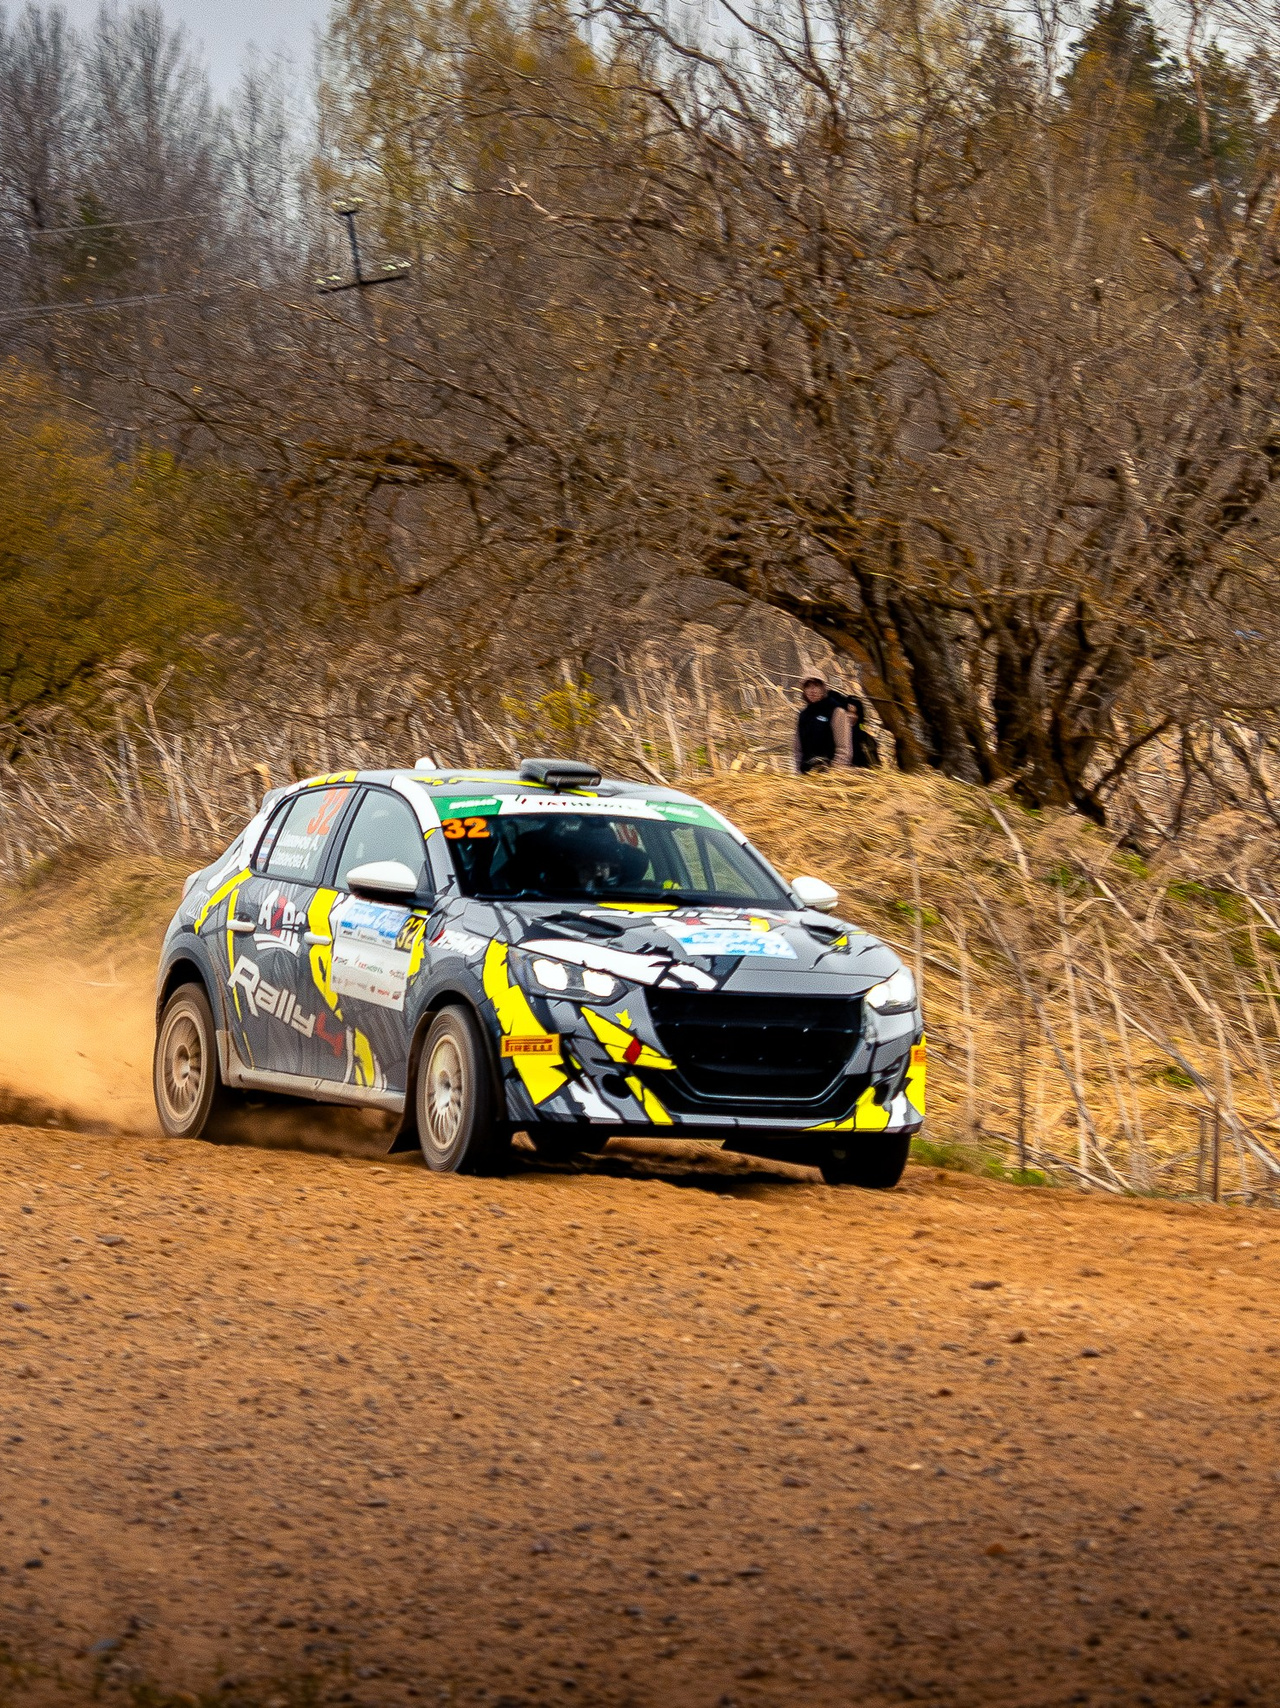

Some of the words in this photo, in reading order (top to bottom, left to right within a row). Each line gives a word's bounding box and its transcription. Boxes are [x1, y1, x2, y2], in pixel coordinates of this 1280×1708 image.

[307, 787, 350, 835] 32
[443, 817, 490, 839] 32
[397, 917, 424, 949] 32
[505, 1039, 553, 1052] PIRELLI
